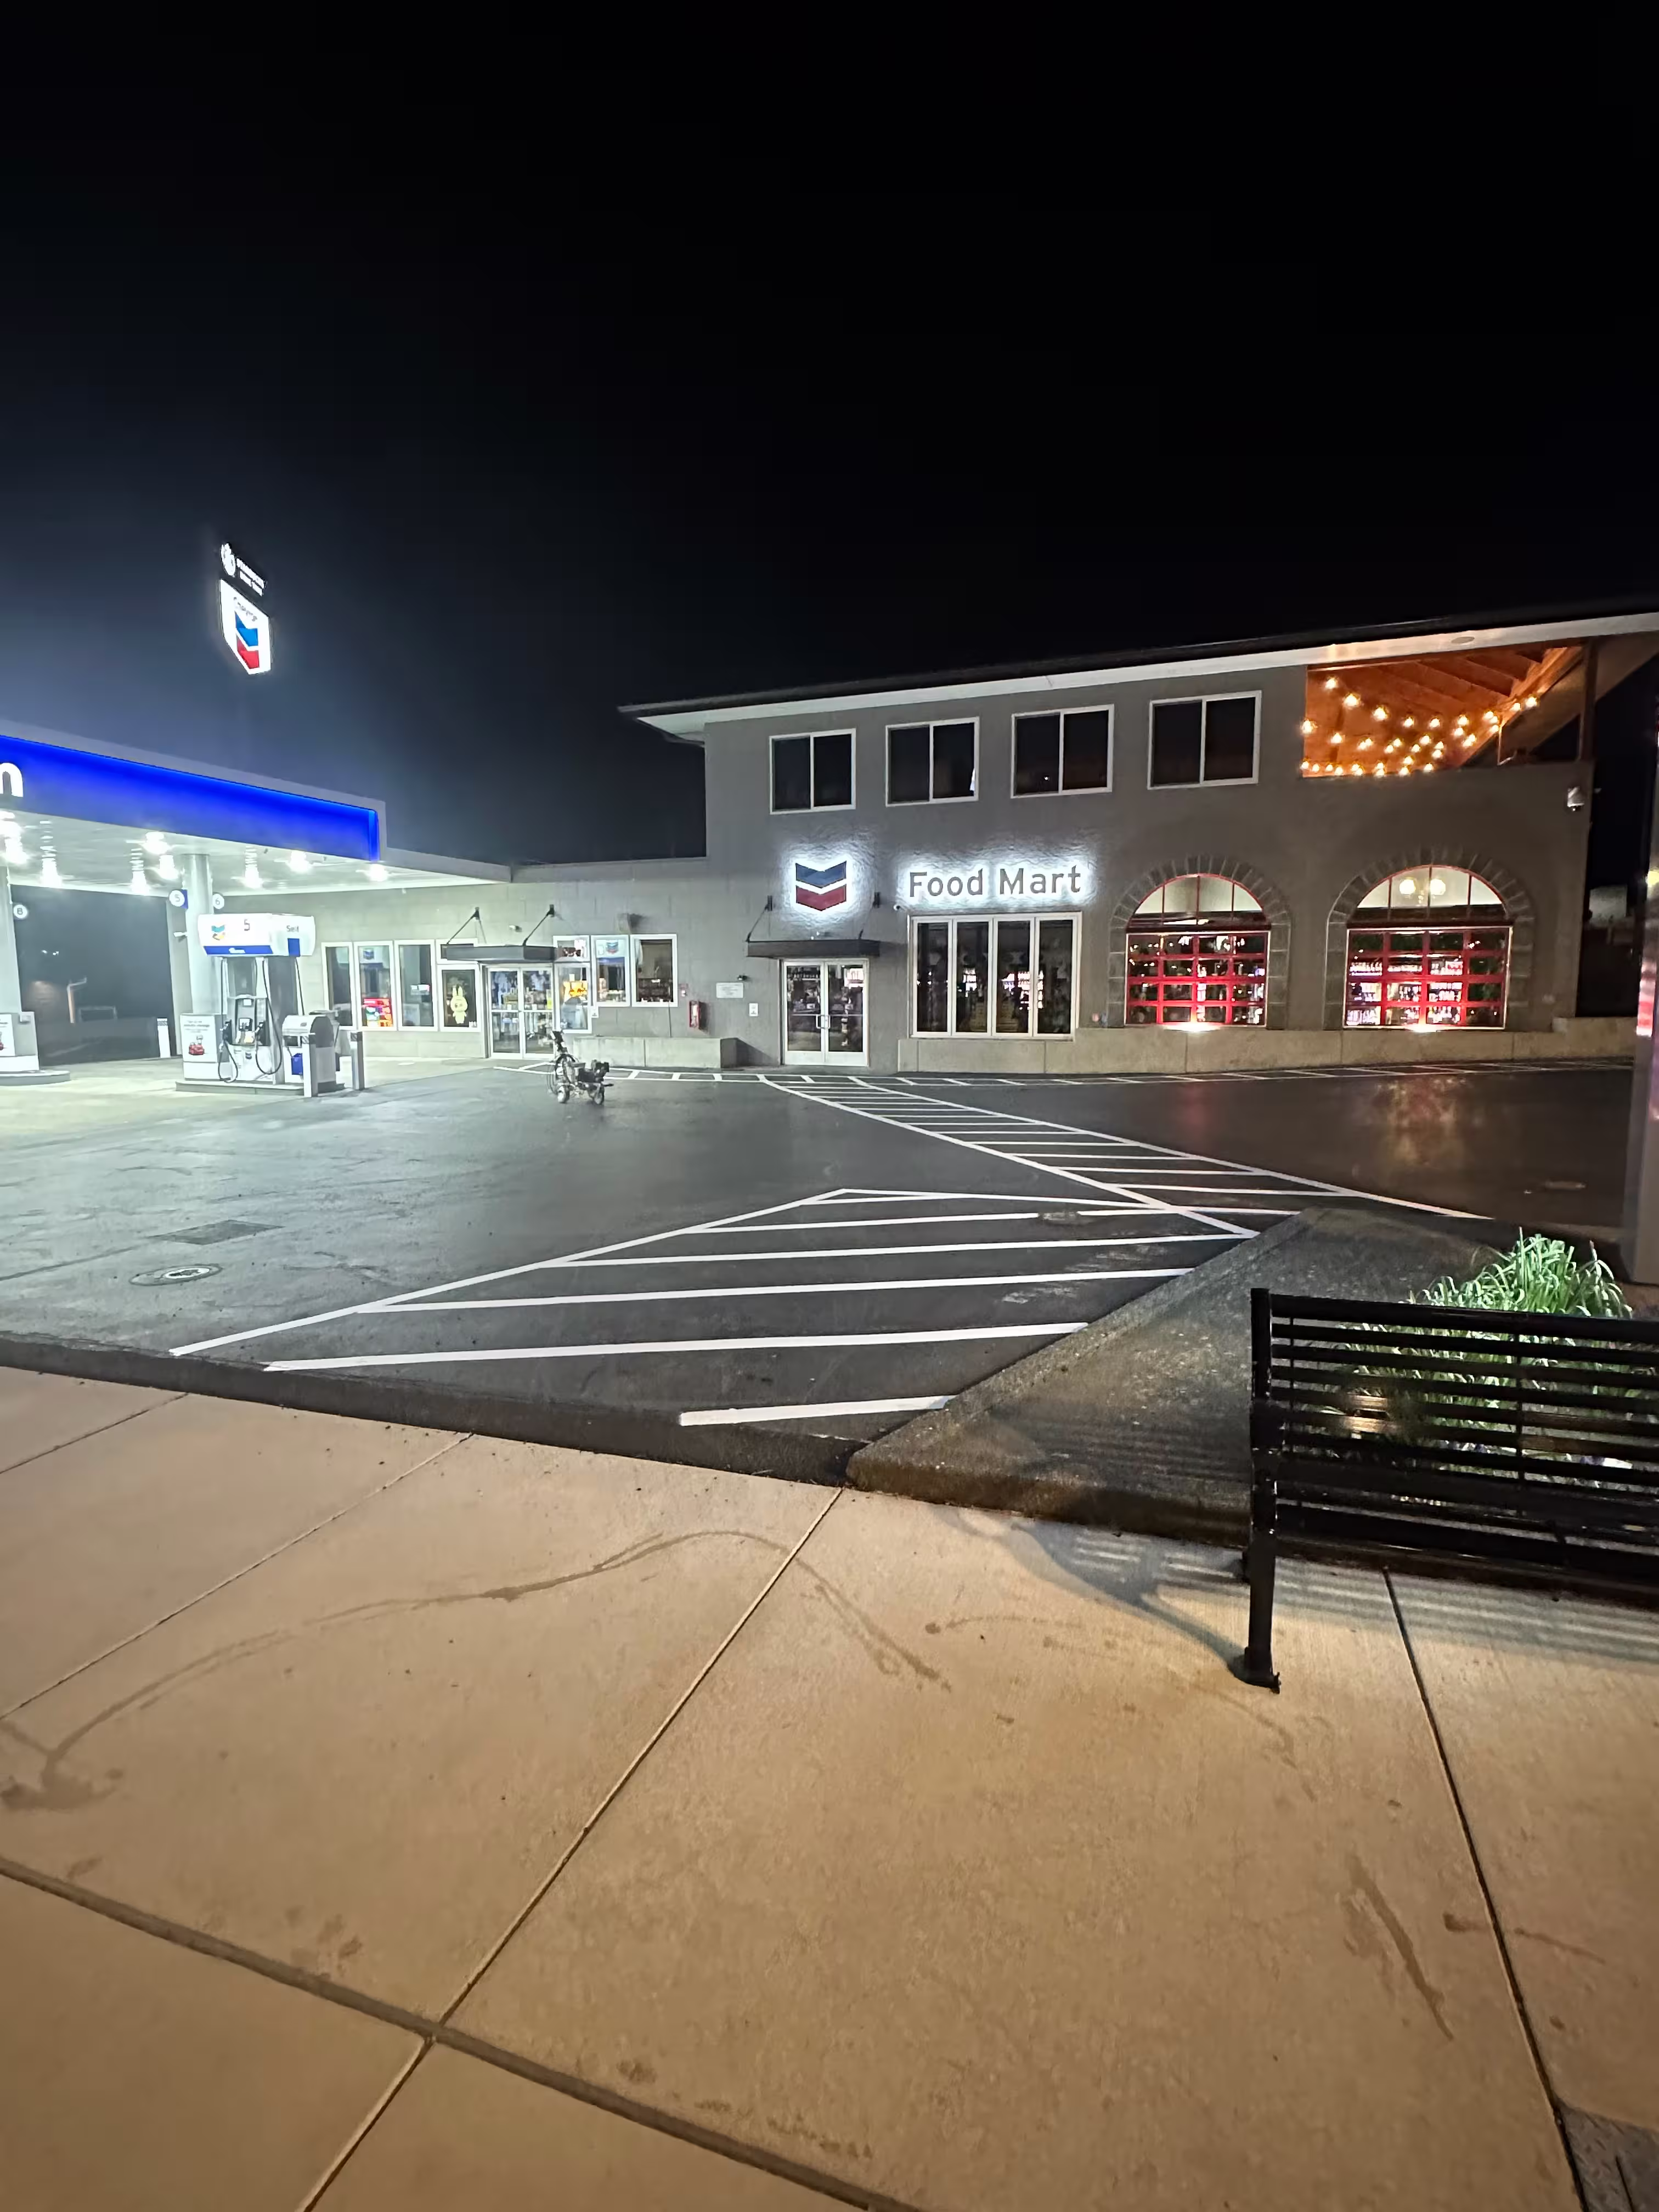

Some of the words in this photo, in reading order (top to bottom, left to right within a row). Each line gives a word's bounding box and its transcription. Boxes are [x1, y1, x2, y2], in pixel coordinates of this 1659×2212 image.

[910, 868, 983, 898] Food
[1000, 865, 1081, 895] Mart
[244, 919, 251, 932] 5
